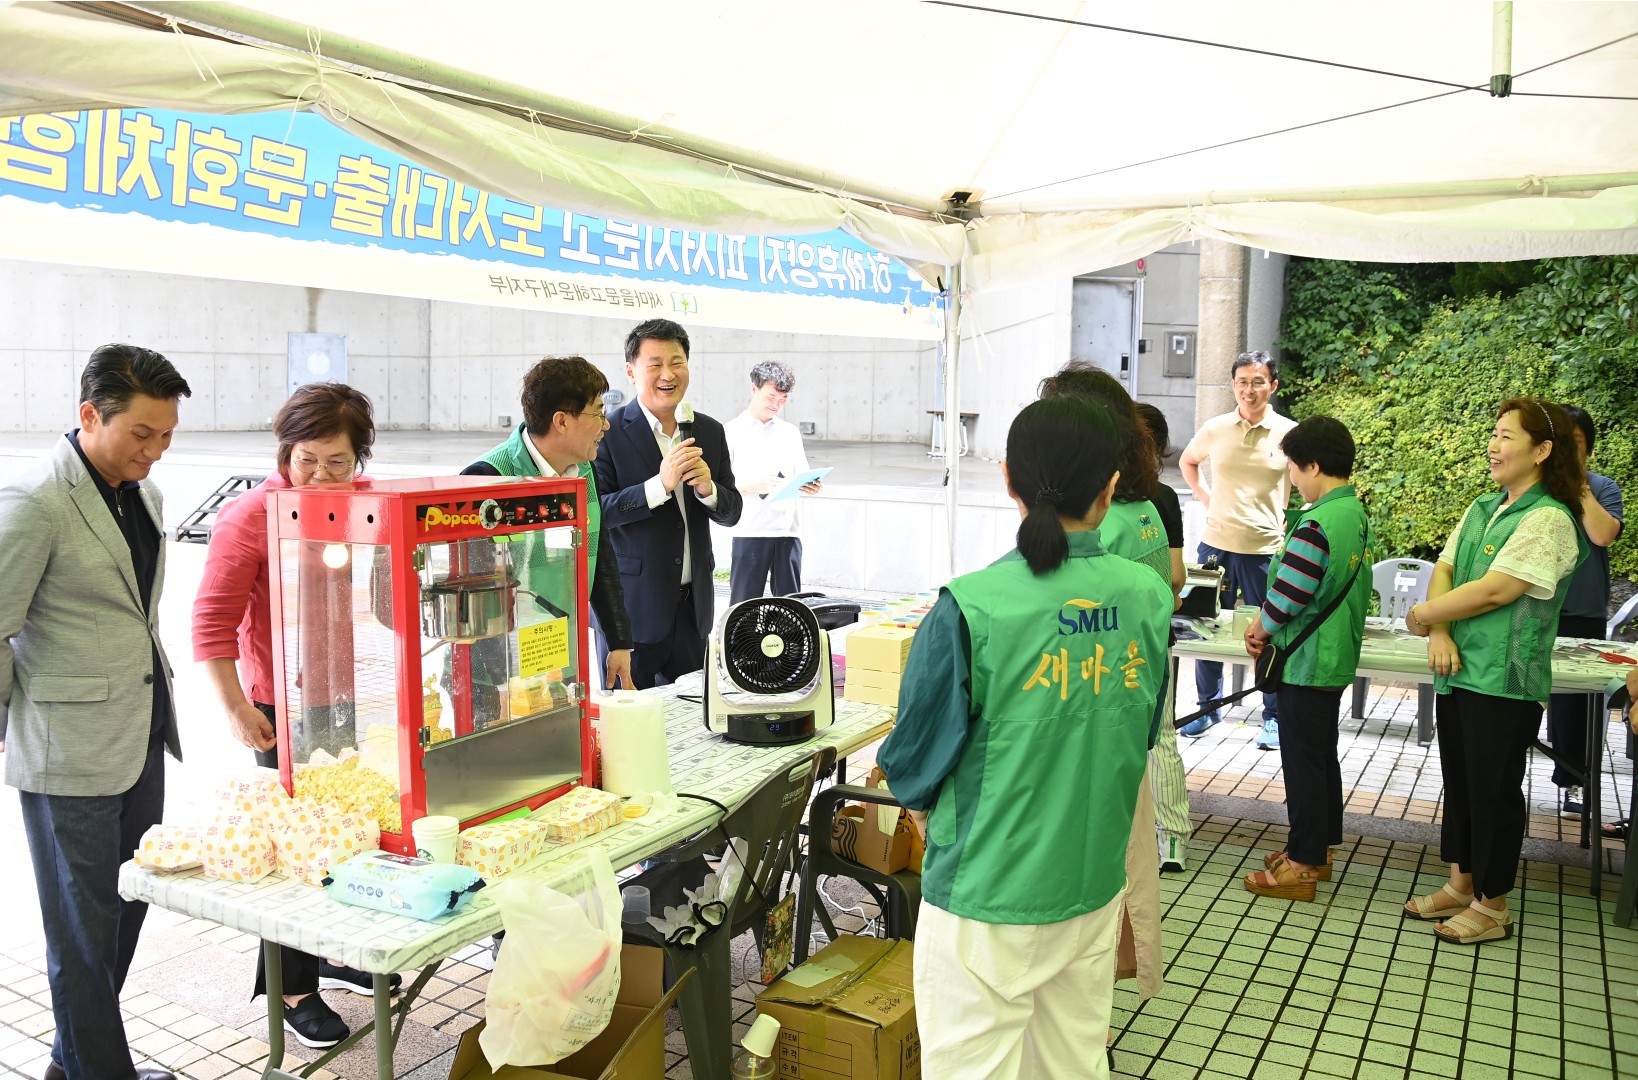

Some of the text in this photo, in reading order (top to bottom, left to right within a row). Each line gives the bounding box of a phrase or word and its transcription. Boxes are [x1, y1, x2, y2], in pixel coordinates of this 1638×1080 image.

[533, 624, 554, 636] 주의사항
[1057, 605, 1119, 636] SMU
[1022, 640, 1147, 701] 새마을
[781, 1031, 798, 1043] ITEM
